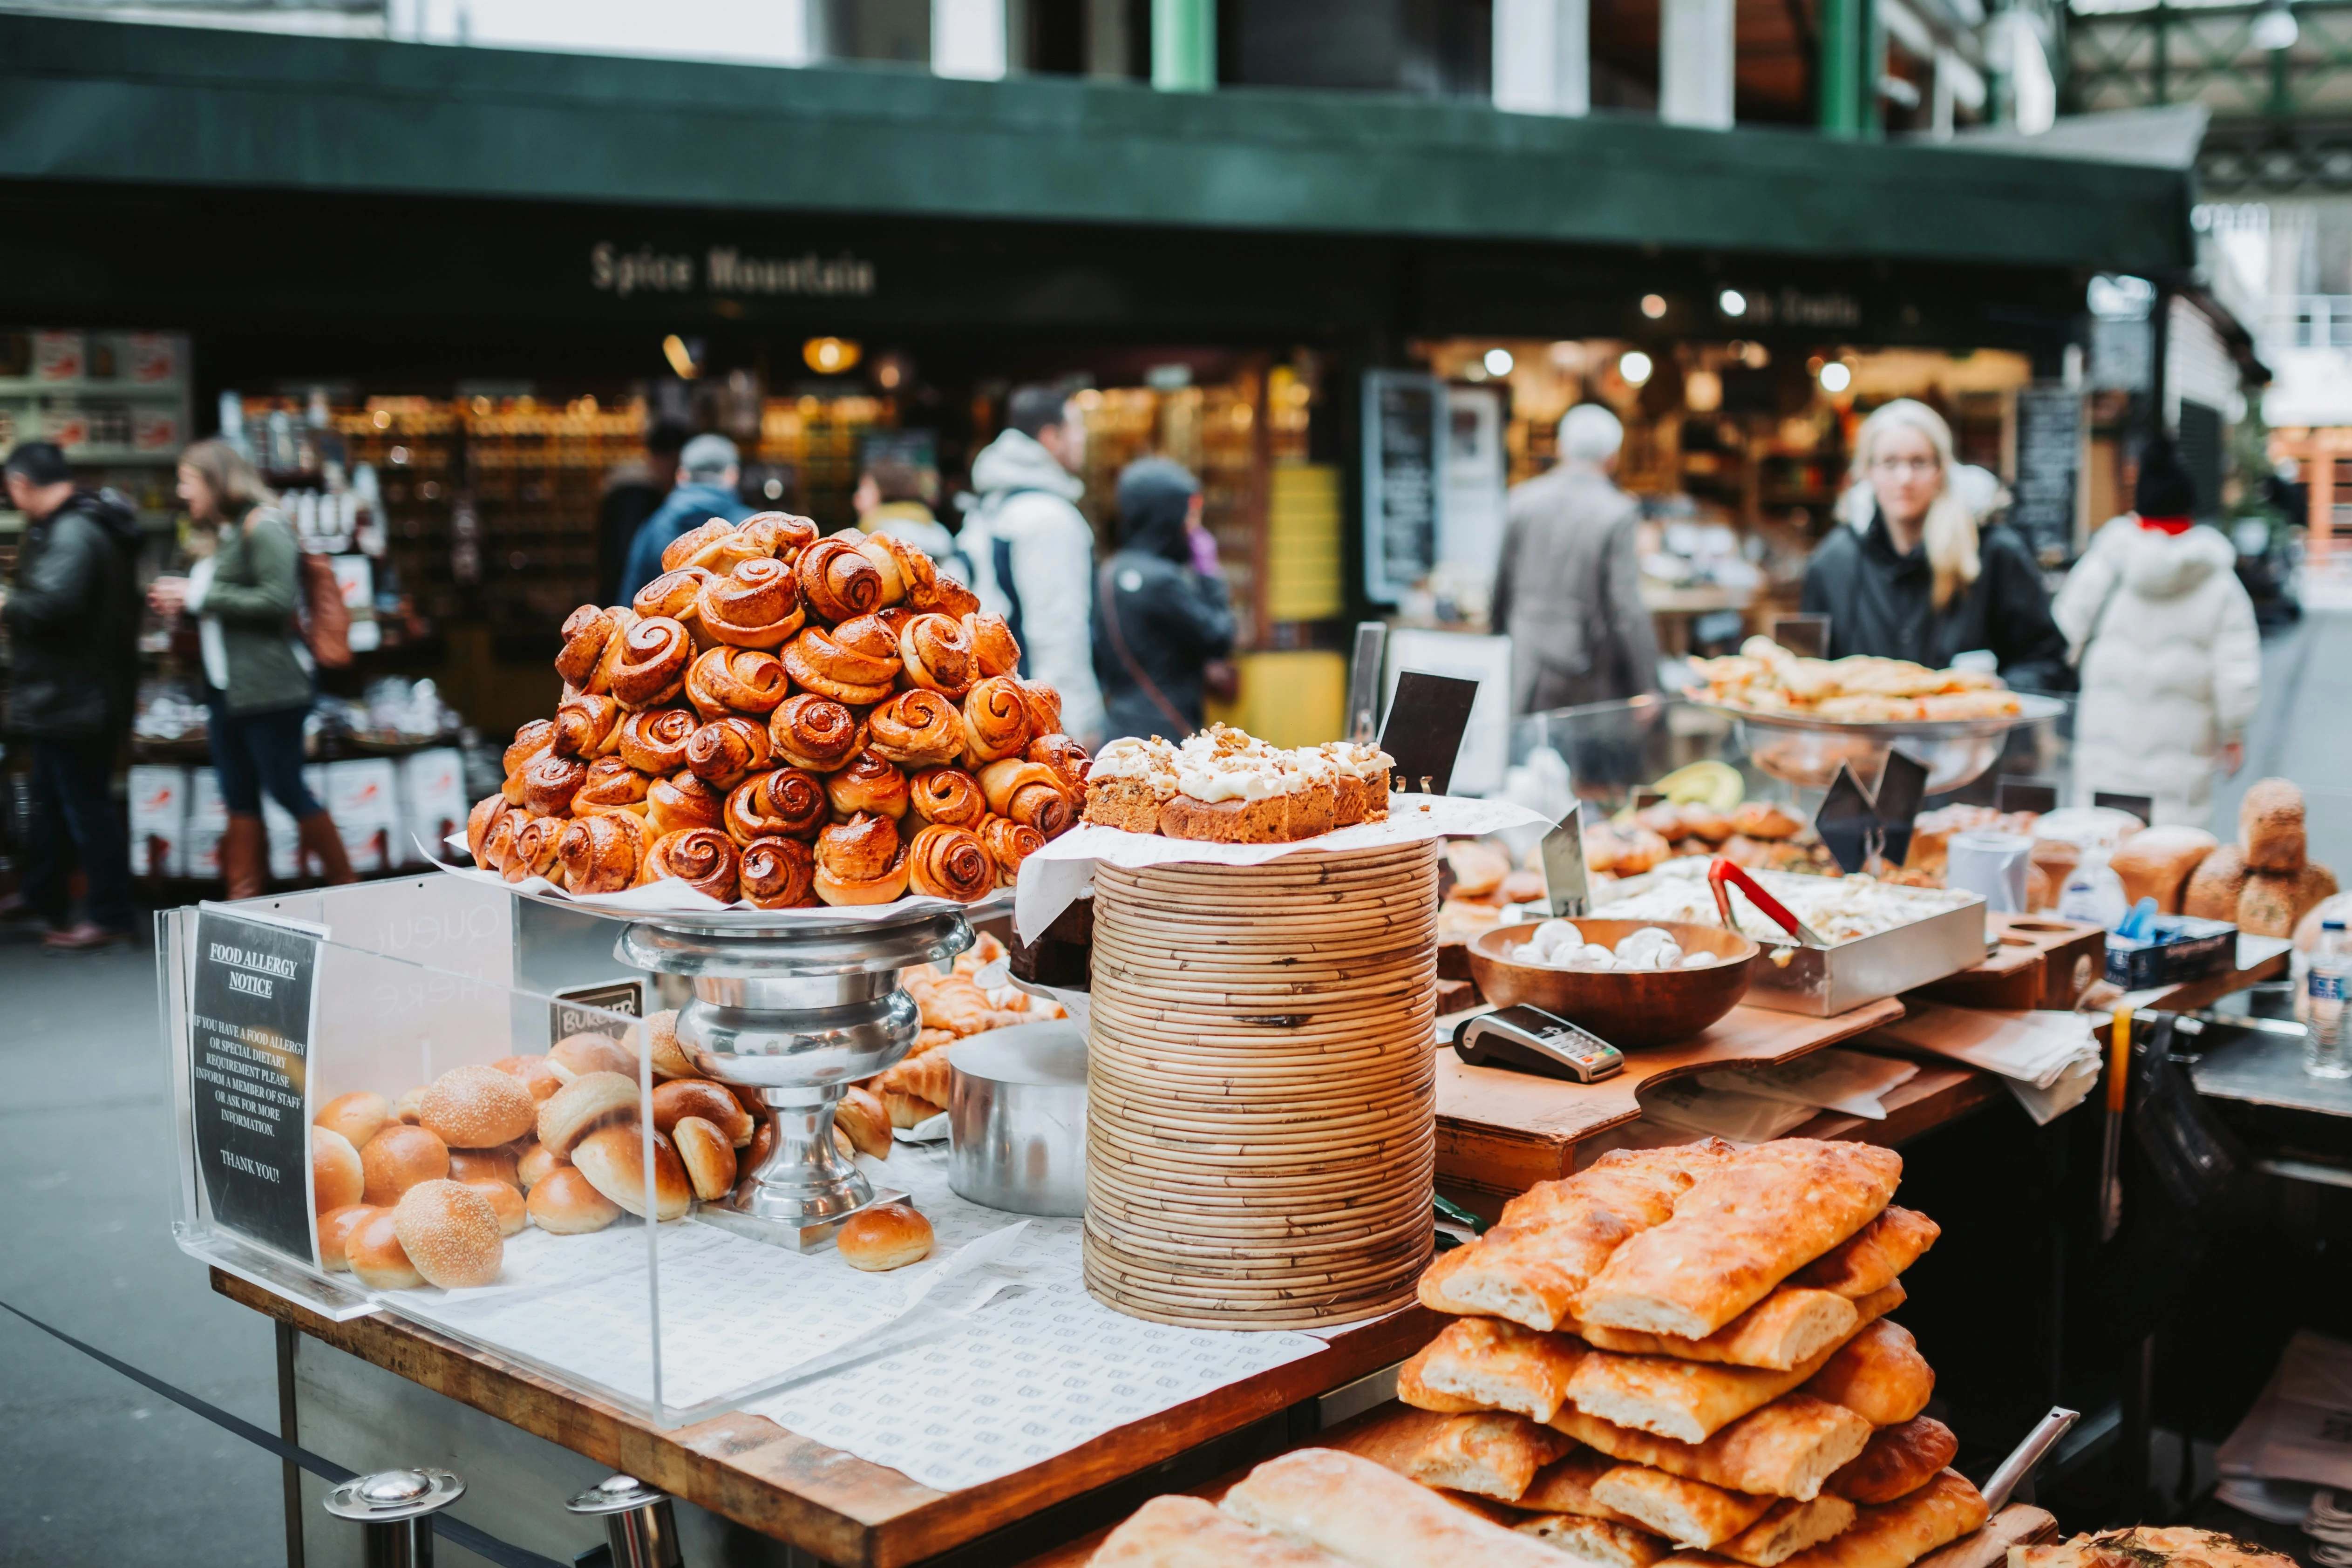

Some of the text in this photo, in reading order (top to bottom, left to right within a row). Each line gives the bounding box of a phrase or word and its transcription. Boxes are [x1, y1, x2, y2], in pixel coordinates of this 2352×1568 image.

[592, 241, 875, 298] Spice Mountain
[210, 943, 298, 977] FOOD ALLERGY
[229, 971, 272, 996] NOTICE
[562, 999, 635, 1033] BURGER
[194, 1014, 306, 1056] IF YOU HAVE A FOOD ALLERGY
[206, 1052, 289, 1088] REQUIREMENT PLEASE
[210, 1037, 286, 1069] OR SPECIAL DIETARY
[196, 1066, 300, 1109] INFORM A MEMBER OF STAFF
[215, 1090, 280, 1121] OR ASK FOR MORE
[221, 1108, 275, 1137] INFORMATION.
[220, 1149, 280, 1184] THANK YOU!
